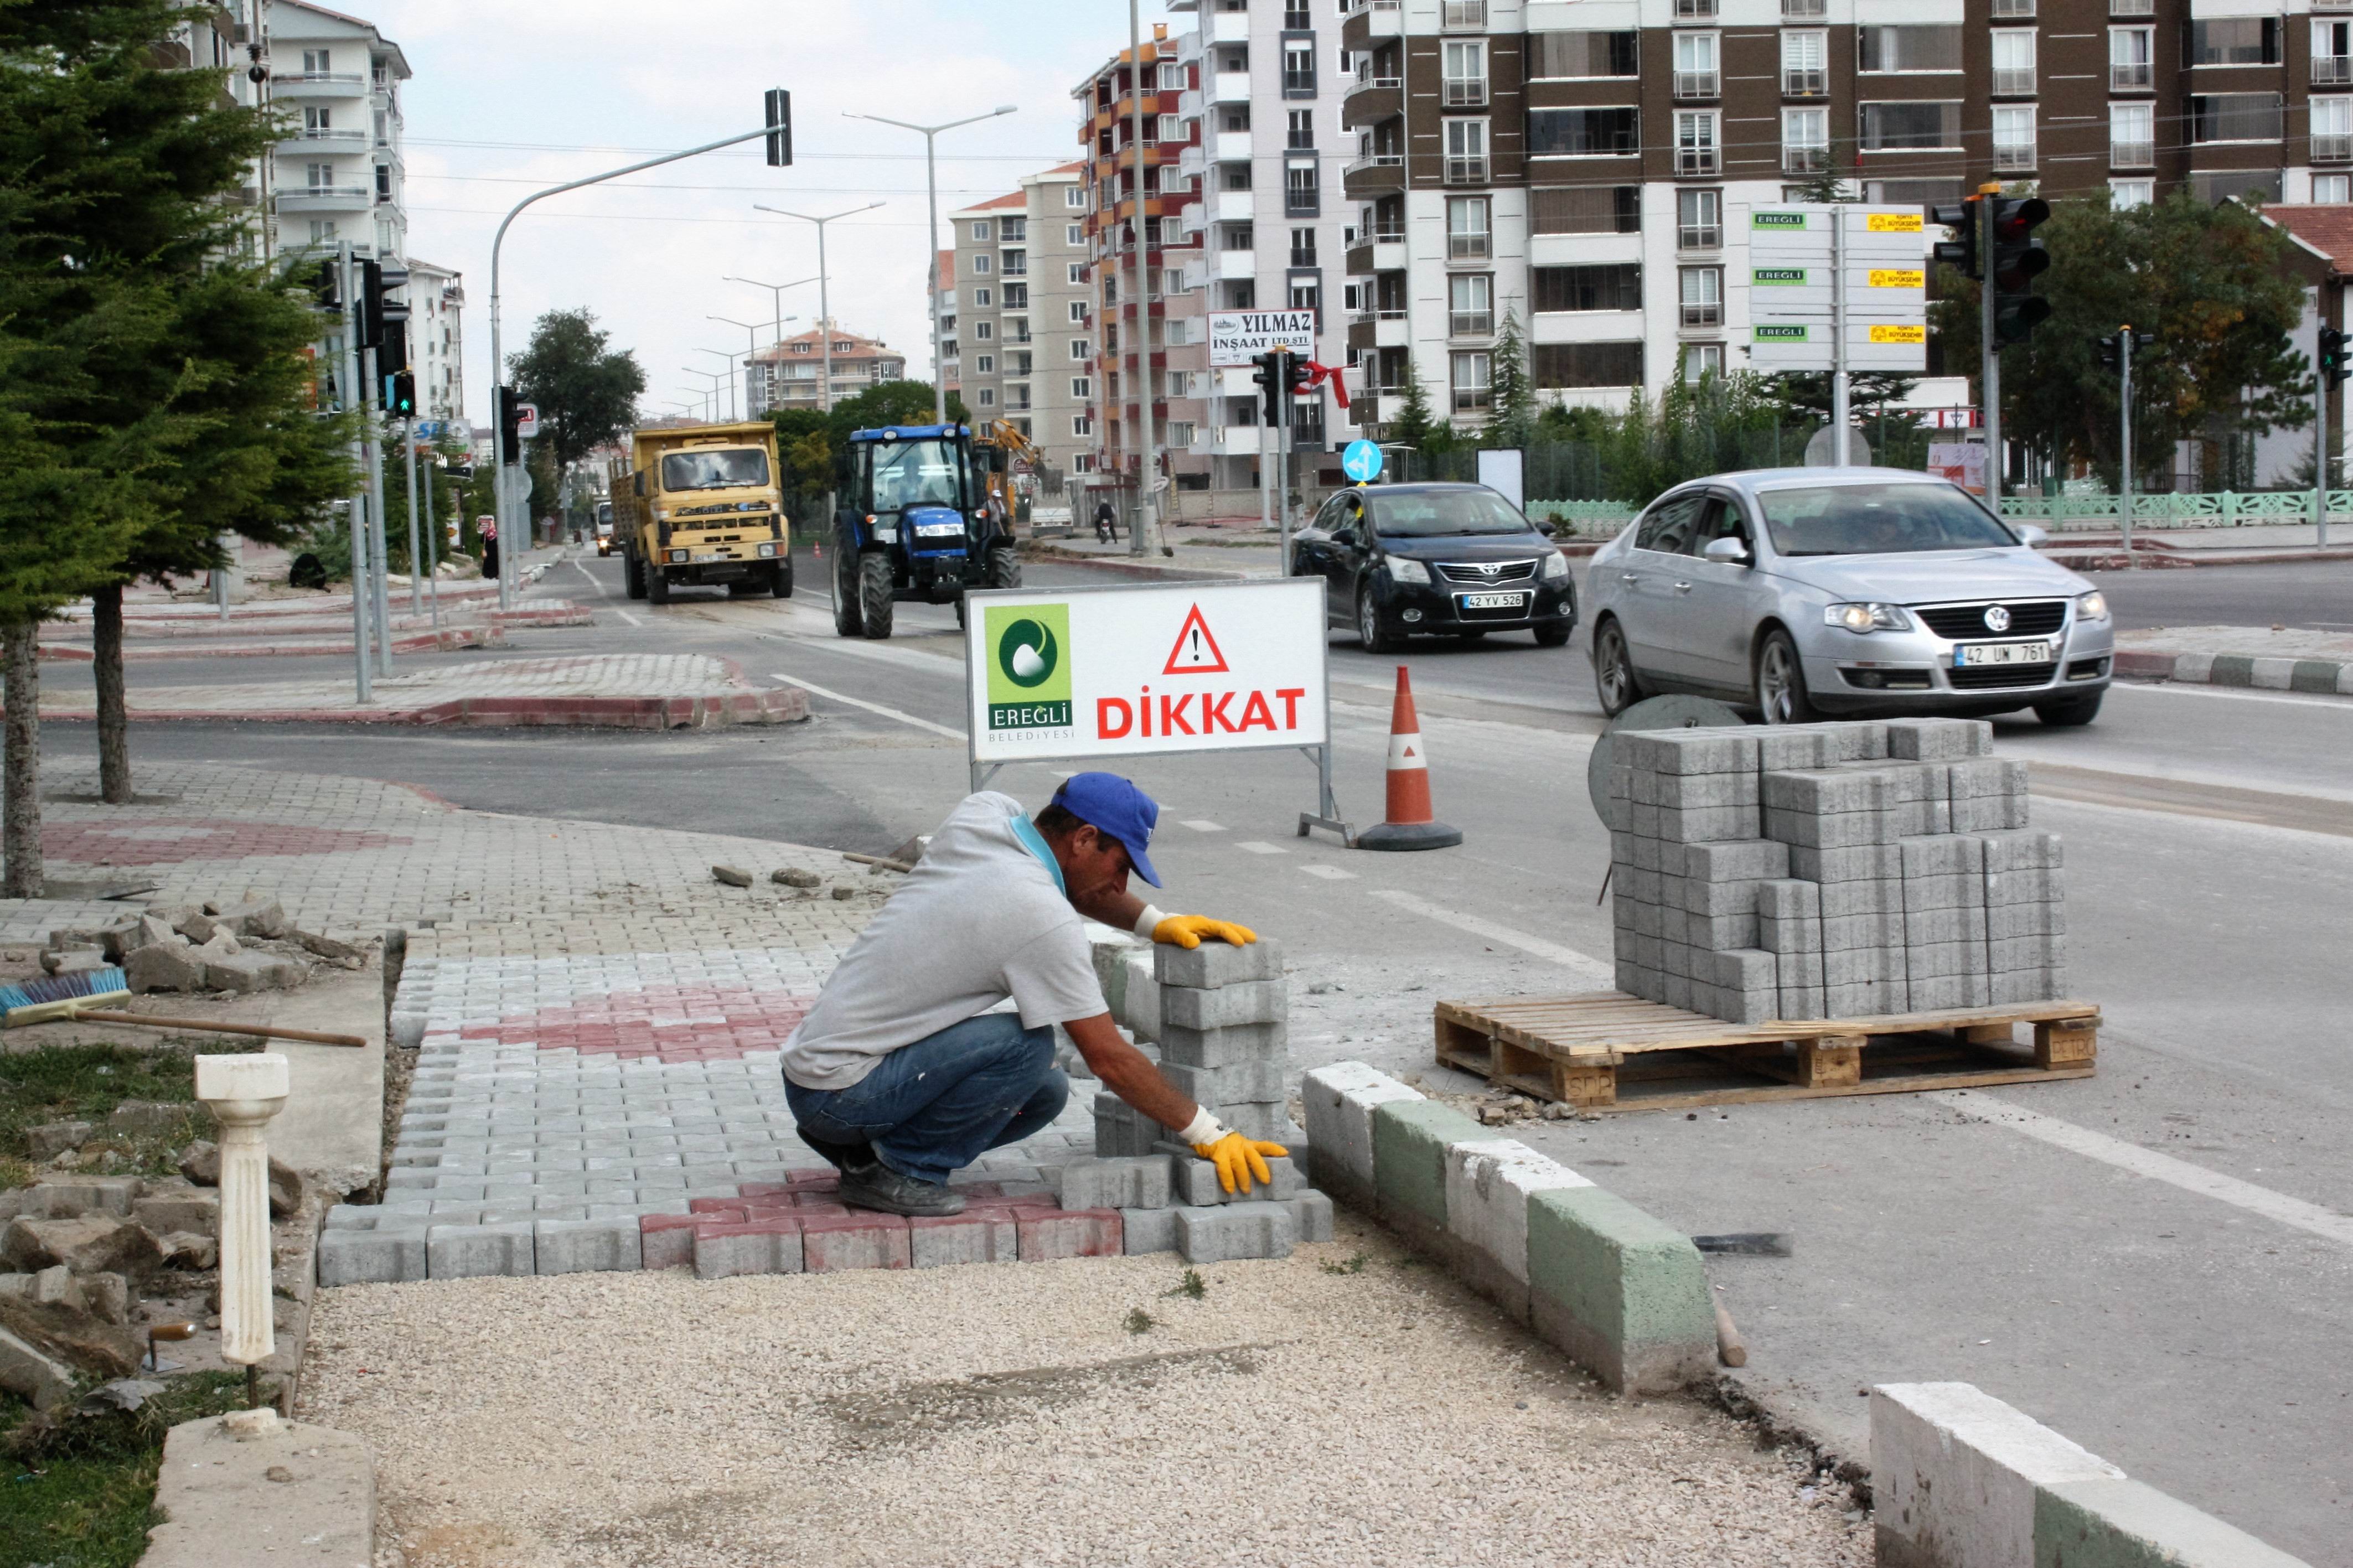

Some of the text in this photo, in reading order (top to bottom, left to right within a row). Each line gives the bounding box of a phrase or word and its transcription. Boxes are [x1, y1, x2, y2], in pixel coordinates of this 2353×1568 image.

[1242, 313, 1311, 333] YILMAZ
[1213, 336, 1268, 351] İNŞAAT
[1470, 596, 1522, 607] 42 YV 526
[1967, 648, 1983, 663] 42
[2021, 645, 2044, 661] 761
[1097, 685, 1305, 739] DİKKAT
[2052, 1037, 2097, 1059] PETRO
[1569, 1074, 1611, 1097] SDP
